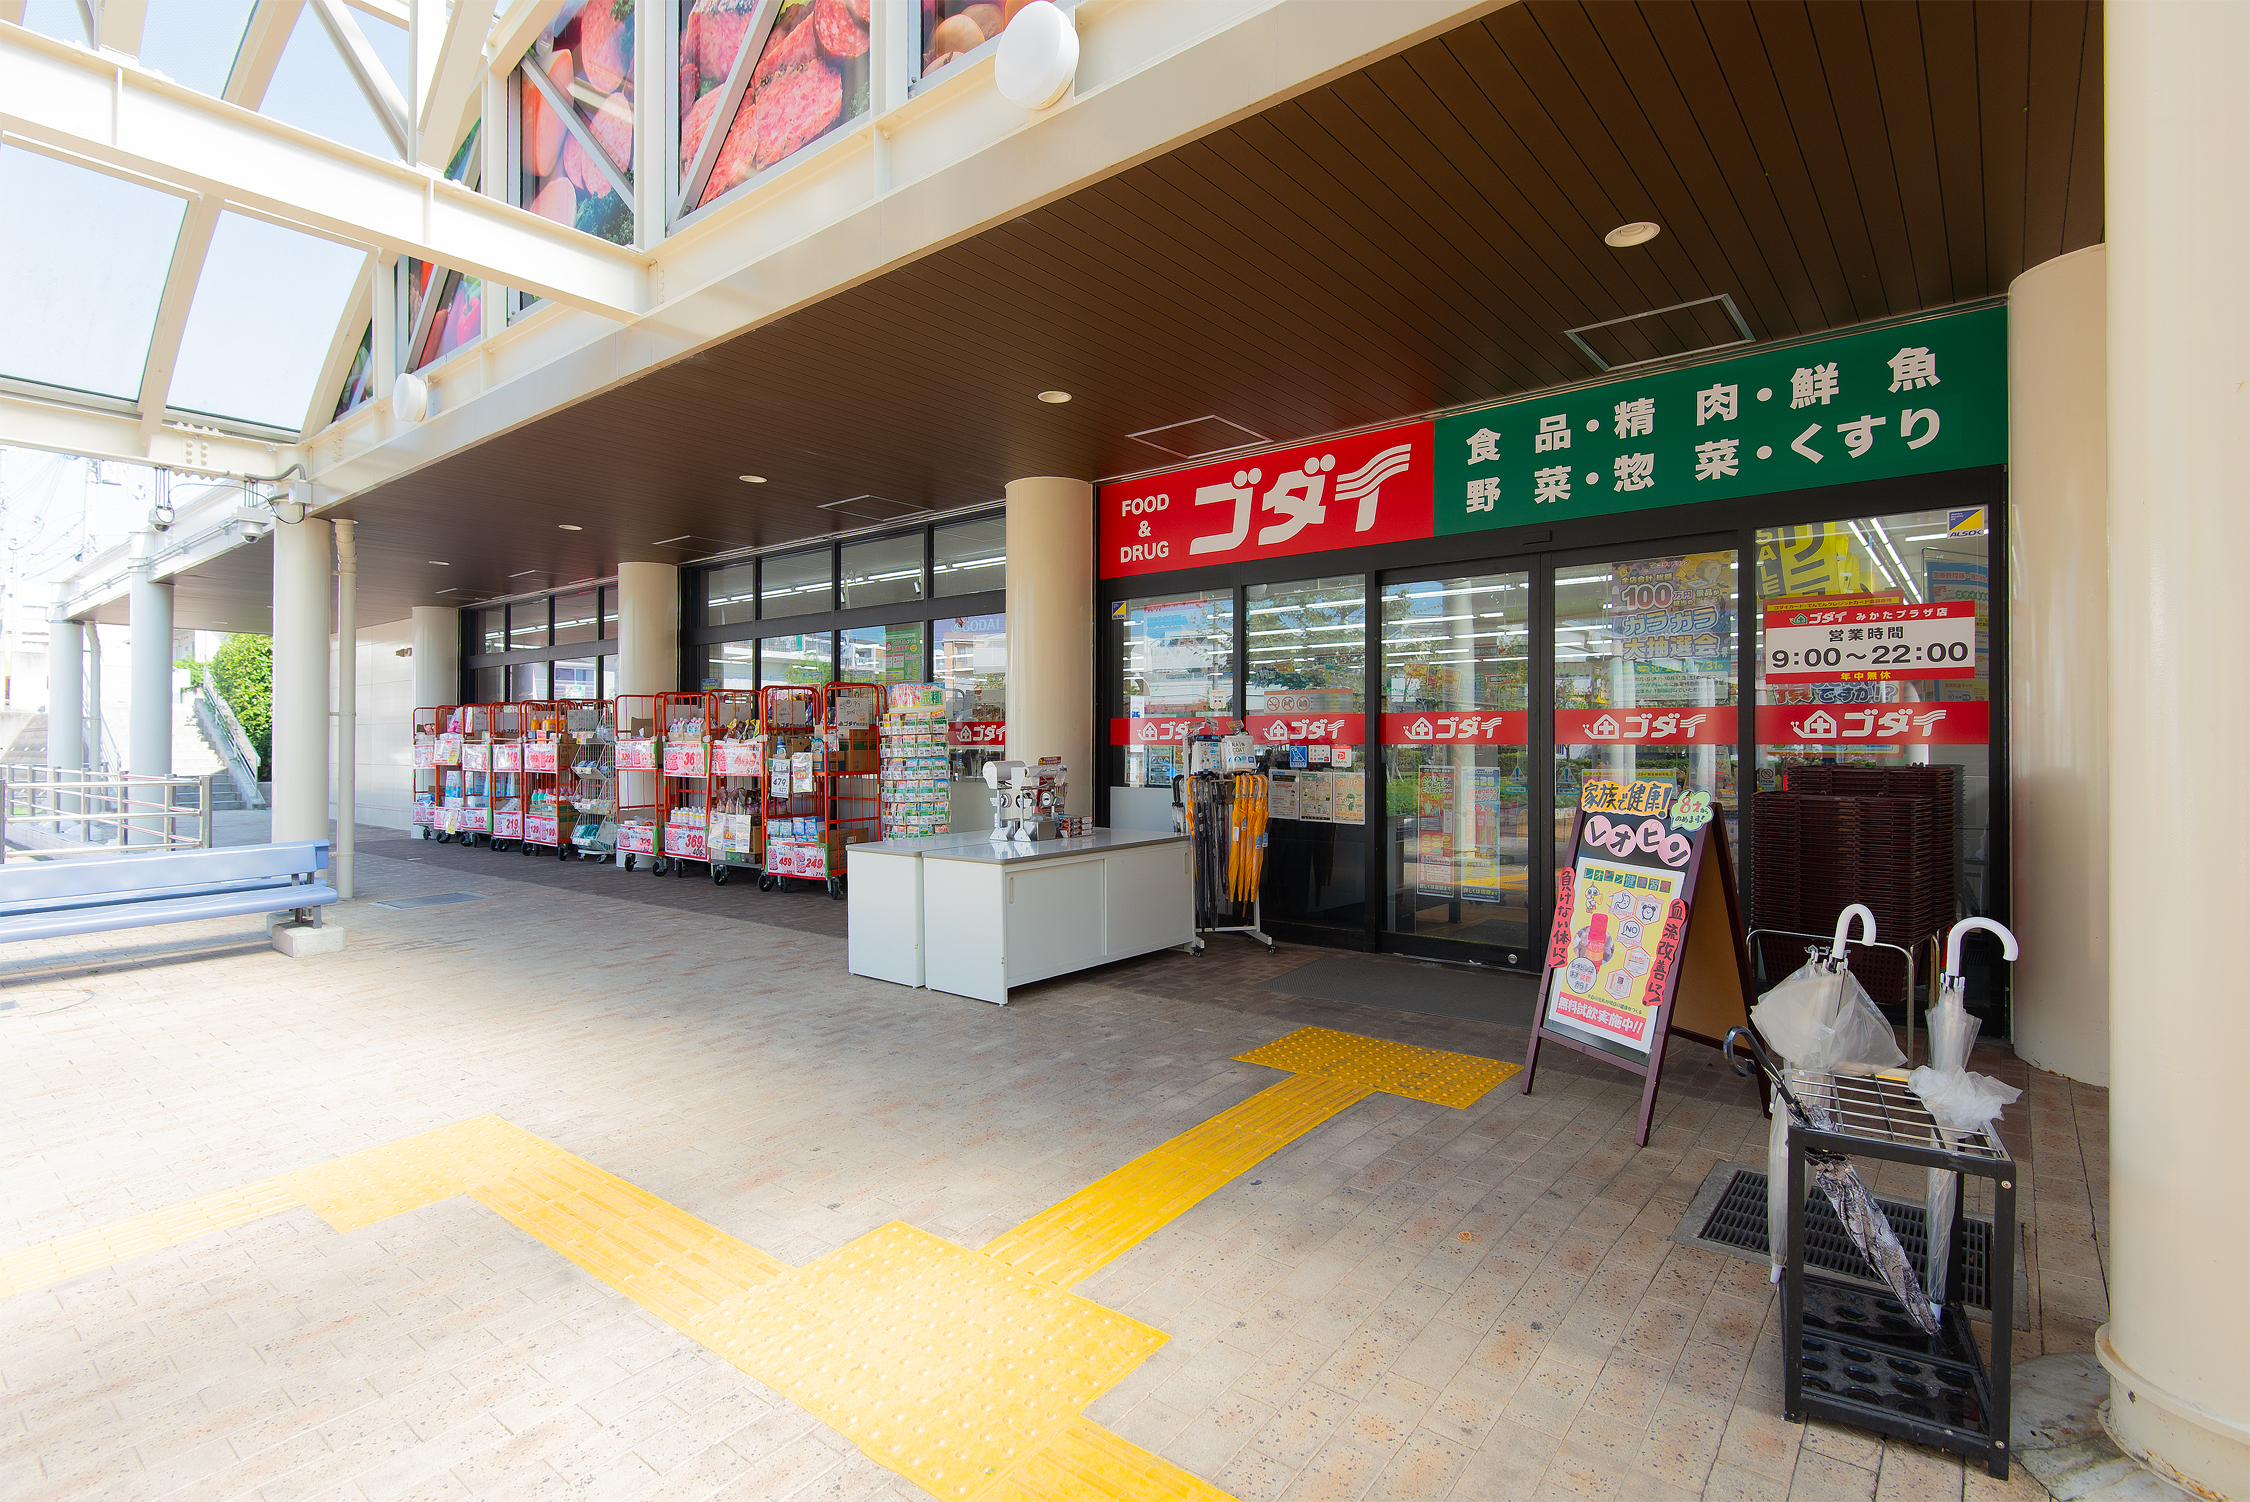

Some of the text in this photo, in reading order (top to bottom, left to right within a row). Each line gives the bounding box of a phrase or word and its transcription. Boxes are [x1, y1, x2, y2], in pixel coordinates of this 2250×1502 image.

[1466, 346, 1941, 466] 食品・精肉・鮮魚
[1466, 407, 1941, 514] 野菜・惣菜・くすり
[1121, 494, 1170, 518] FOOD
[1189, 443, 1412, 556] ゴダイ
[1138, 520, 1152, 538] &
[1949, 529, 1982, 538] ALSOK
[1120, 541, 1170, 563] DRUG
[1757, 529, 1781, 595] SALE
[962, 618, 1000, 632] GODAI
[1623, 605, 1719, 637] ガラガラ
[1809, 611, 1848, 624] ゴダイ
[1623, 633, 1720, 660] 大抽選会
[1828, 626, 1905, 643] 営業時間
[1840, 671, 1892, 681] 年中無休
[1290, 719, 1346, 740] ゴダイ
[1436, 716, 1503, 739] ゴダイ
[1623, 712, 1707, 738] ゴダイ
[1842, 709, 1947, 738] ゴダイ
[1583, 782, 1673, 818] 家族で健康!
[685, 834, 704, 849] 369
[1590, 821, 1688, 864] レオピン
[806, 858, 824, 868] 249
[1549, 870, 1574, 968] 負けない体に!
[1625, 925, 1638, 934] NO
[1643, 901, 1684, 1006] 血流改善に!
[1557, 996, 1644, 1034] 無料試飲実施中!!
